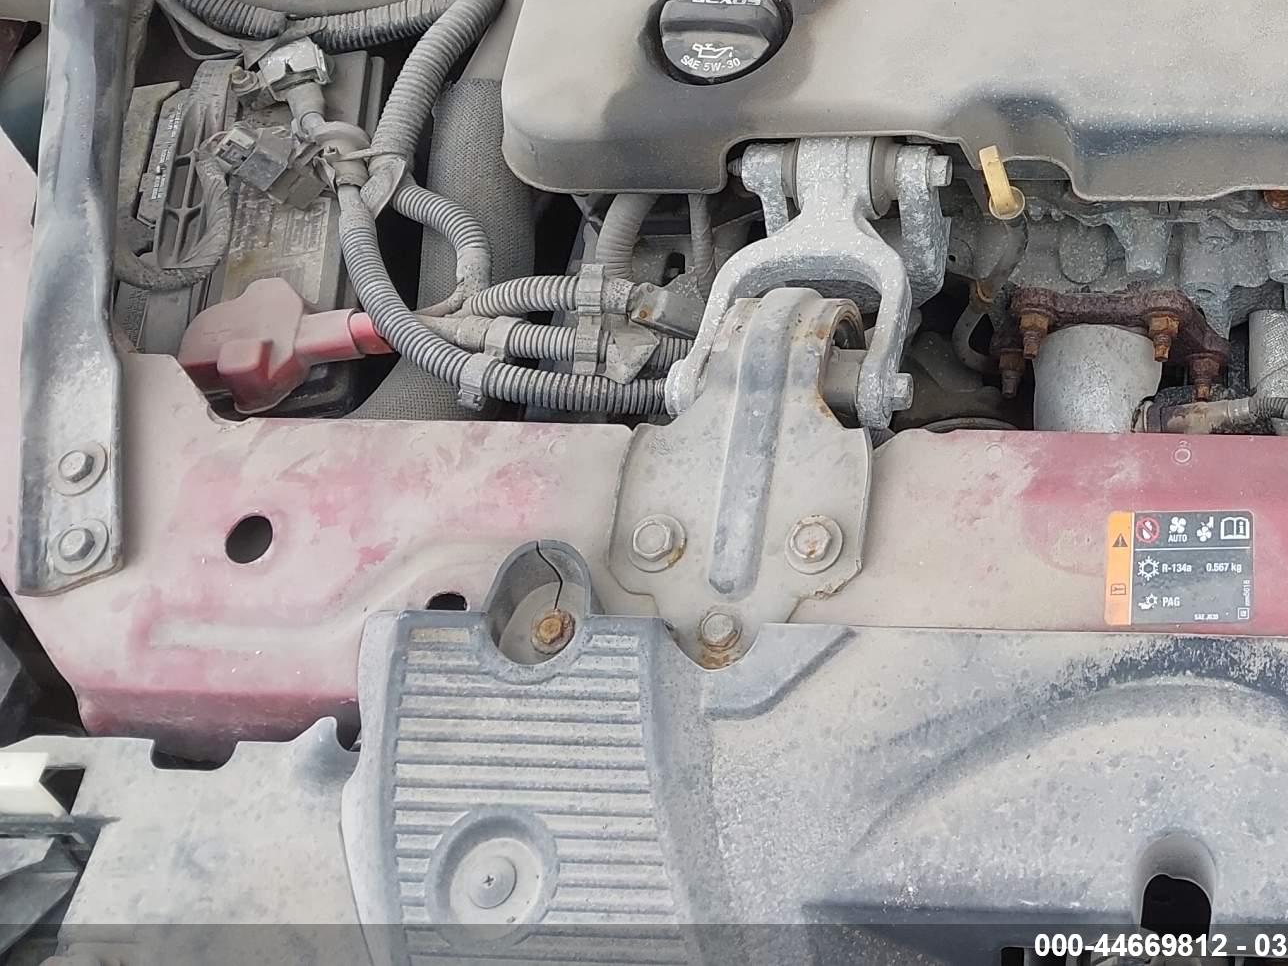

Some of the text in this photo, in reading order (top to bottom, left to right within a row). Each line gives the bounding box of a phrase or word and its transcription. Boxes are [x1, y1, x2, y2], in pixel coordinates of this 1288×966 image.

[680, 55, 741, 72] SAE 5W-30
[1168, 534, 1188, 543] AUTO
[1161, 563, 1193, 572] R-134a
[1231, 562, 1242, 573] kg
[1162, 596, 1181, 607] PAG
